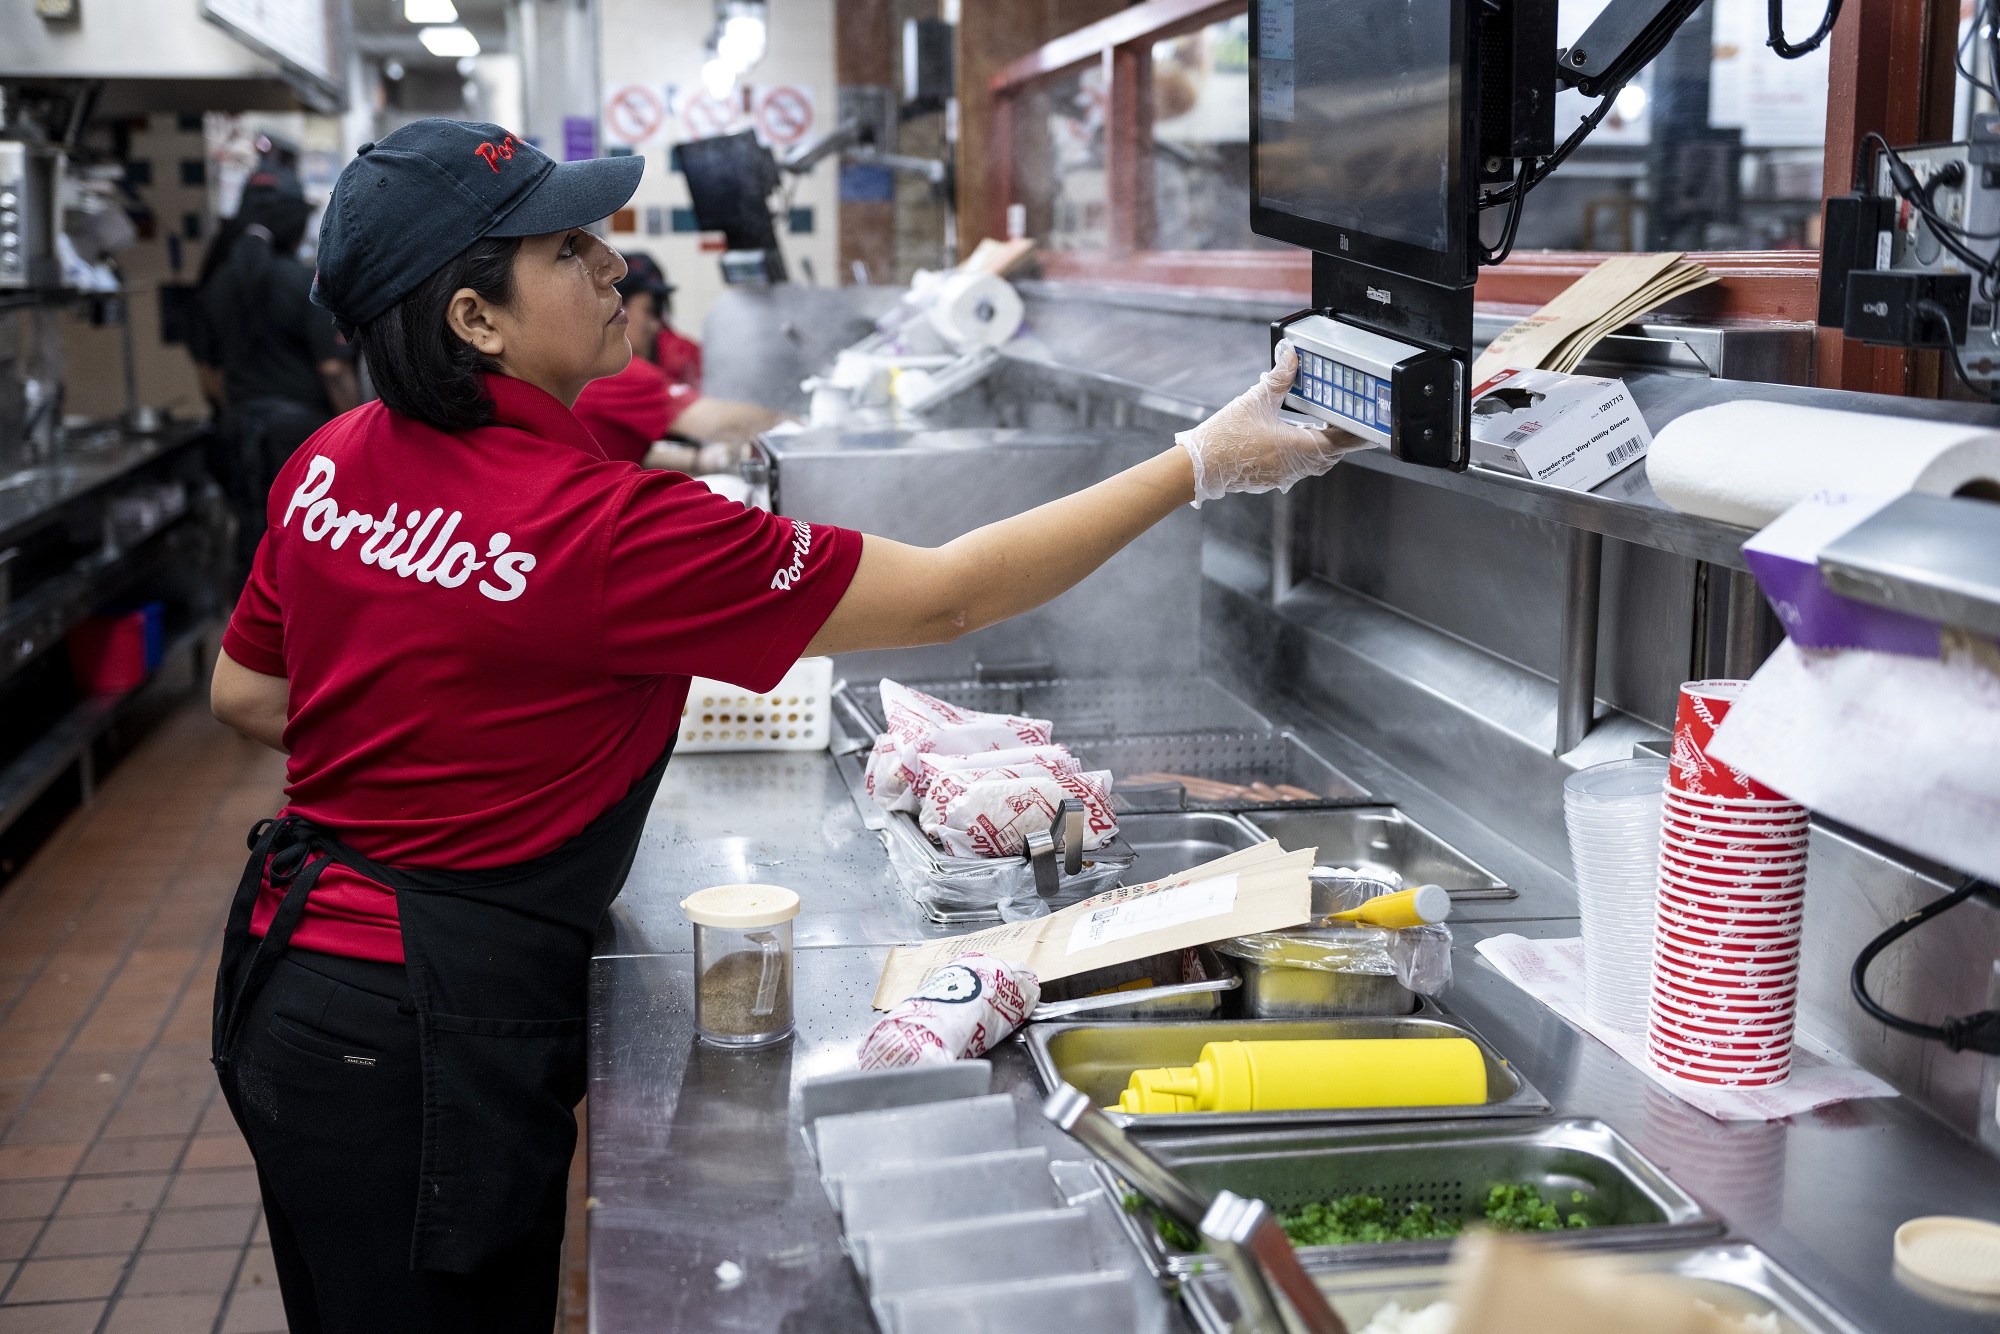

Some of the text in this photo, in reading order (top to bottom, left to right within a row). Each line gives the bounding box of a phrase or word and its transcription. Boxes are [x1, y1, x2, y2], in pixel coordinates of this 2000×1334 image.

[1377, 397, 1391, 412] PRIN
[1598, 394, 1624, 413] 1201713
[1537, 416, 1630, 477] Powder-Free Vinyl Utility Gloves
[284, 455, 536, 601] Portillo's
[979, 816, 996, 834] SALADS
